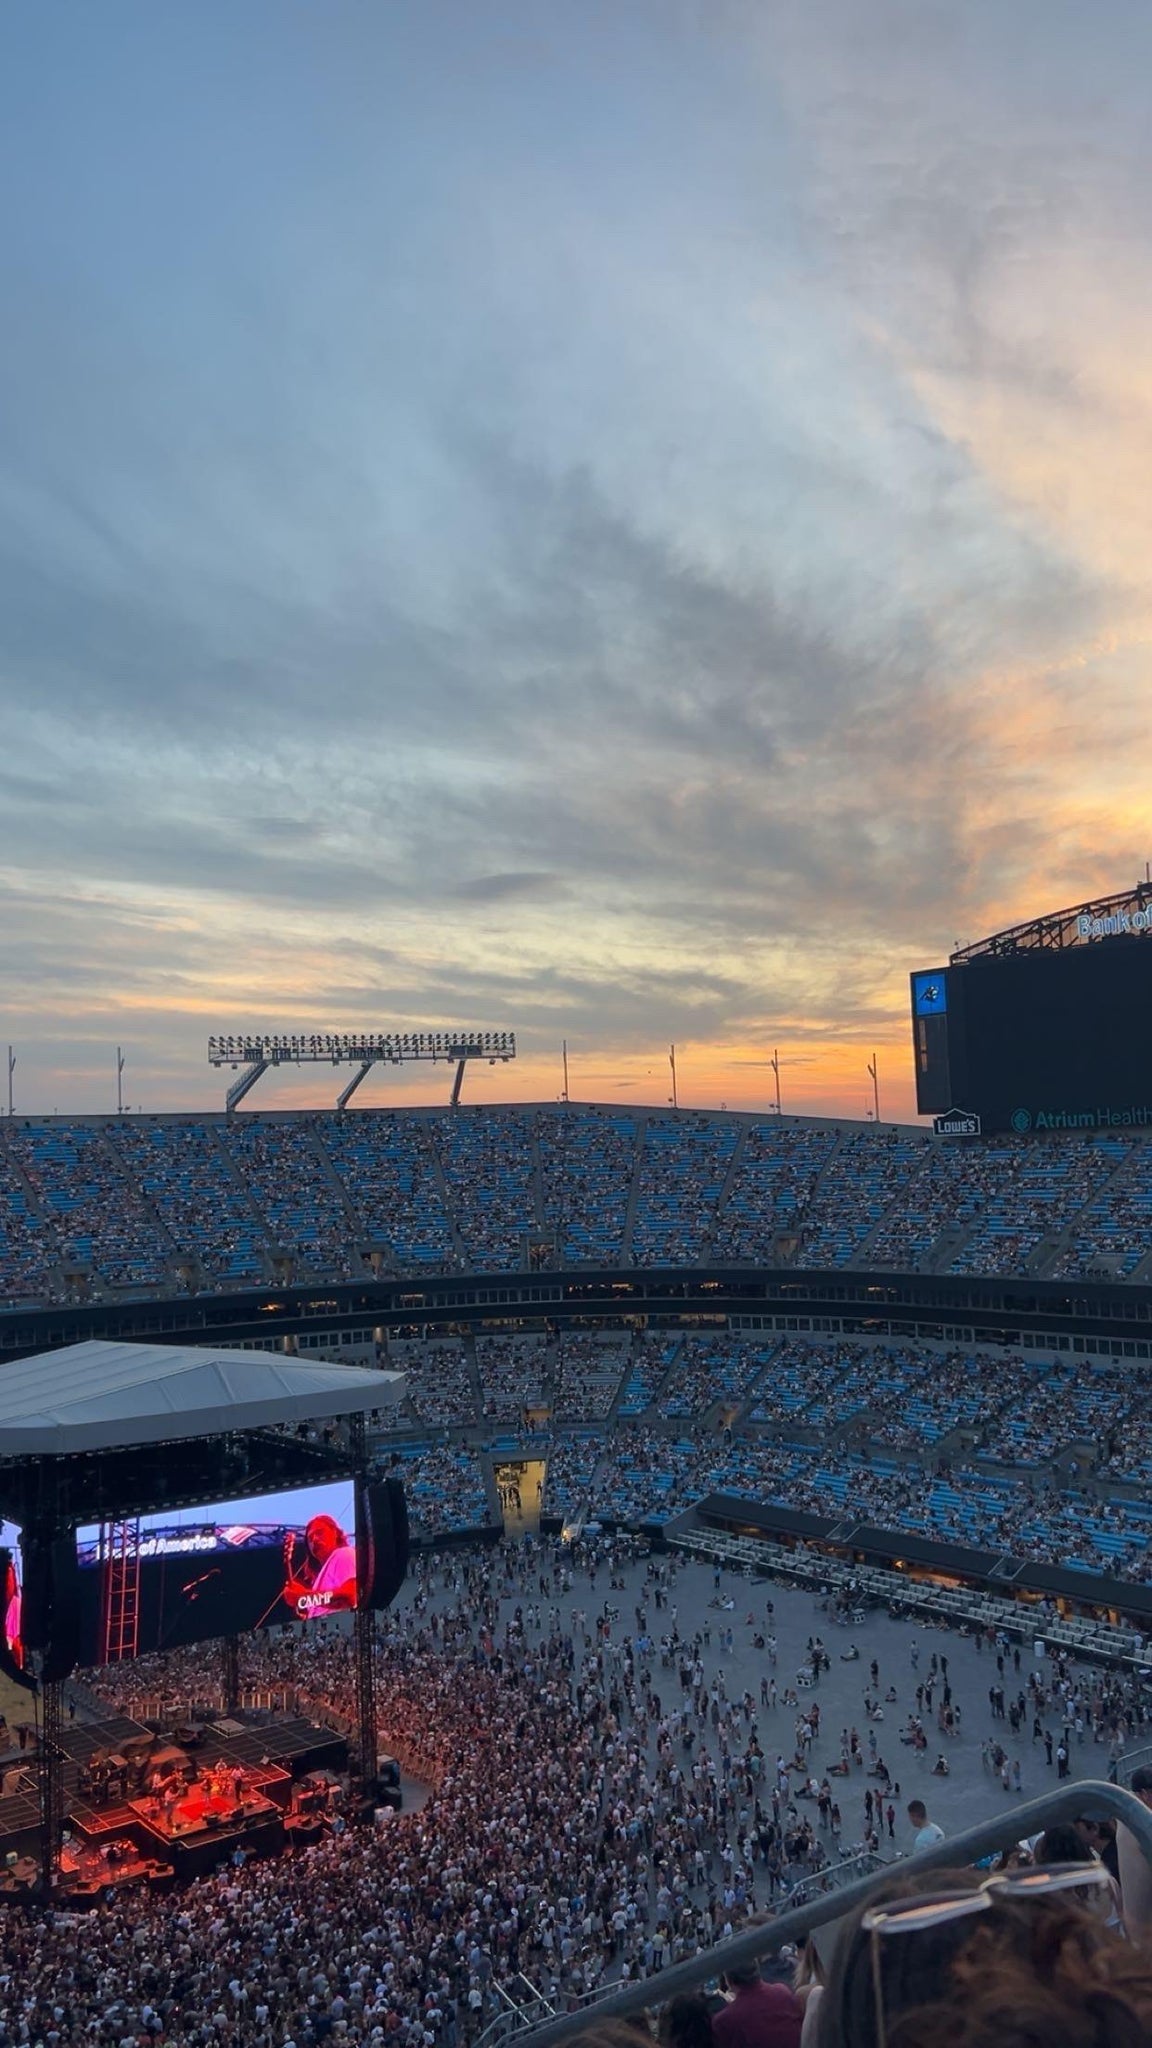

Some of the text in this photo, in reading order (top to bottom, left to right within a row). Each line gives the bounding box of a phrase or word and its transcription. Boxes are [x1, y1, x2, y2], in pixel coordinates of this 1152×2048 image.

[1077, 909, 1131, 937] Bank
[937, 1118, 976, 1133] LOWE'S
[1035, 1105, 1152, 1129] Atrium Health
[156, 1534, 217, 1555] America
